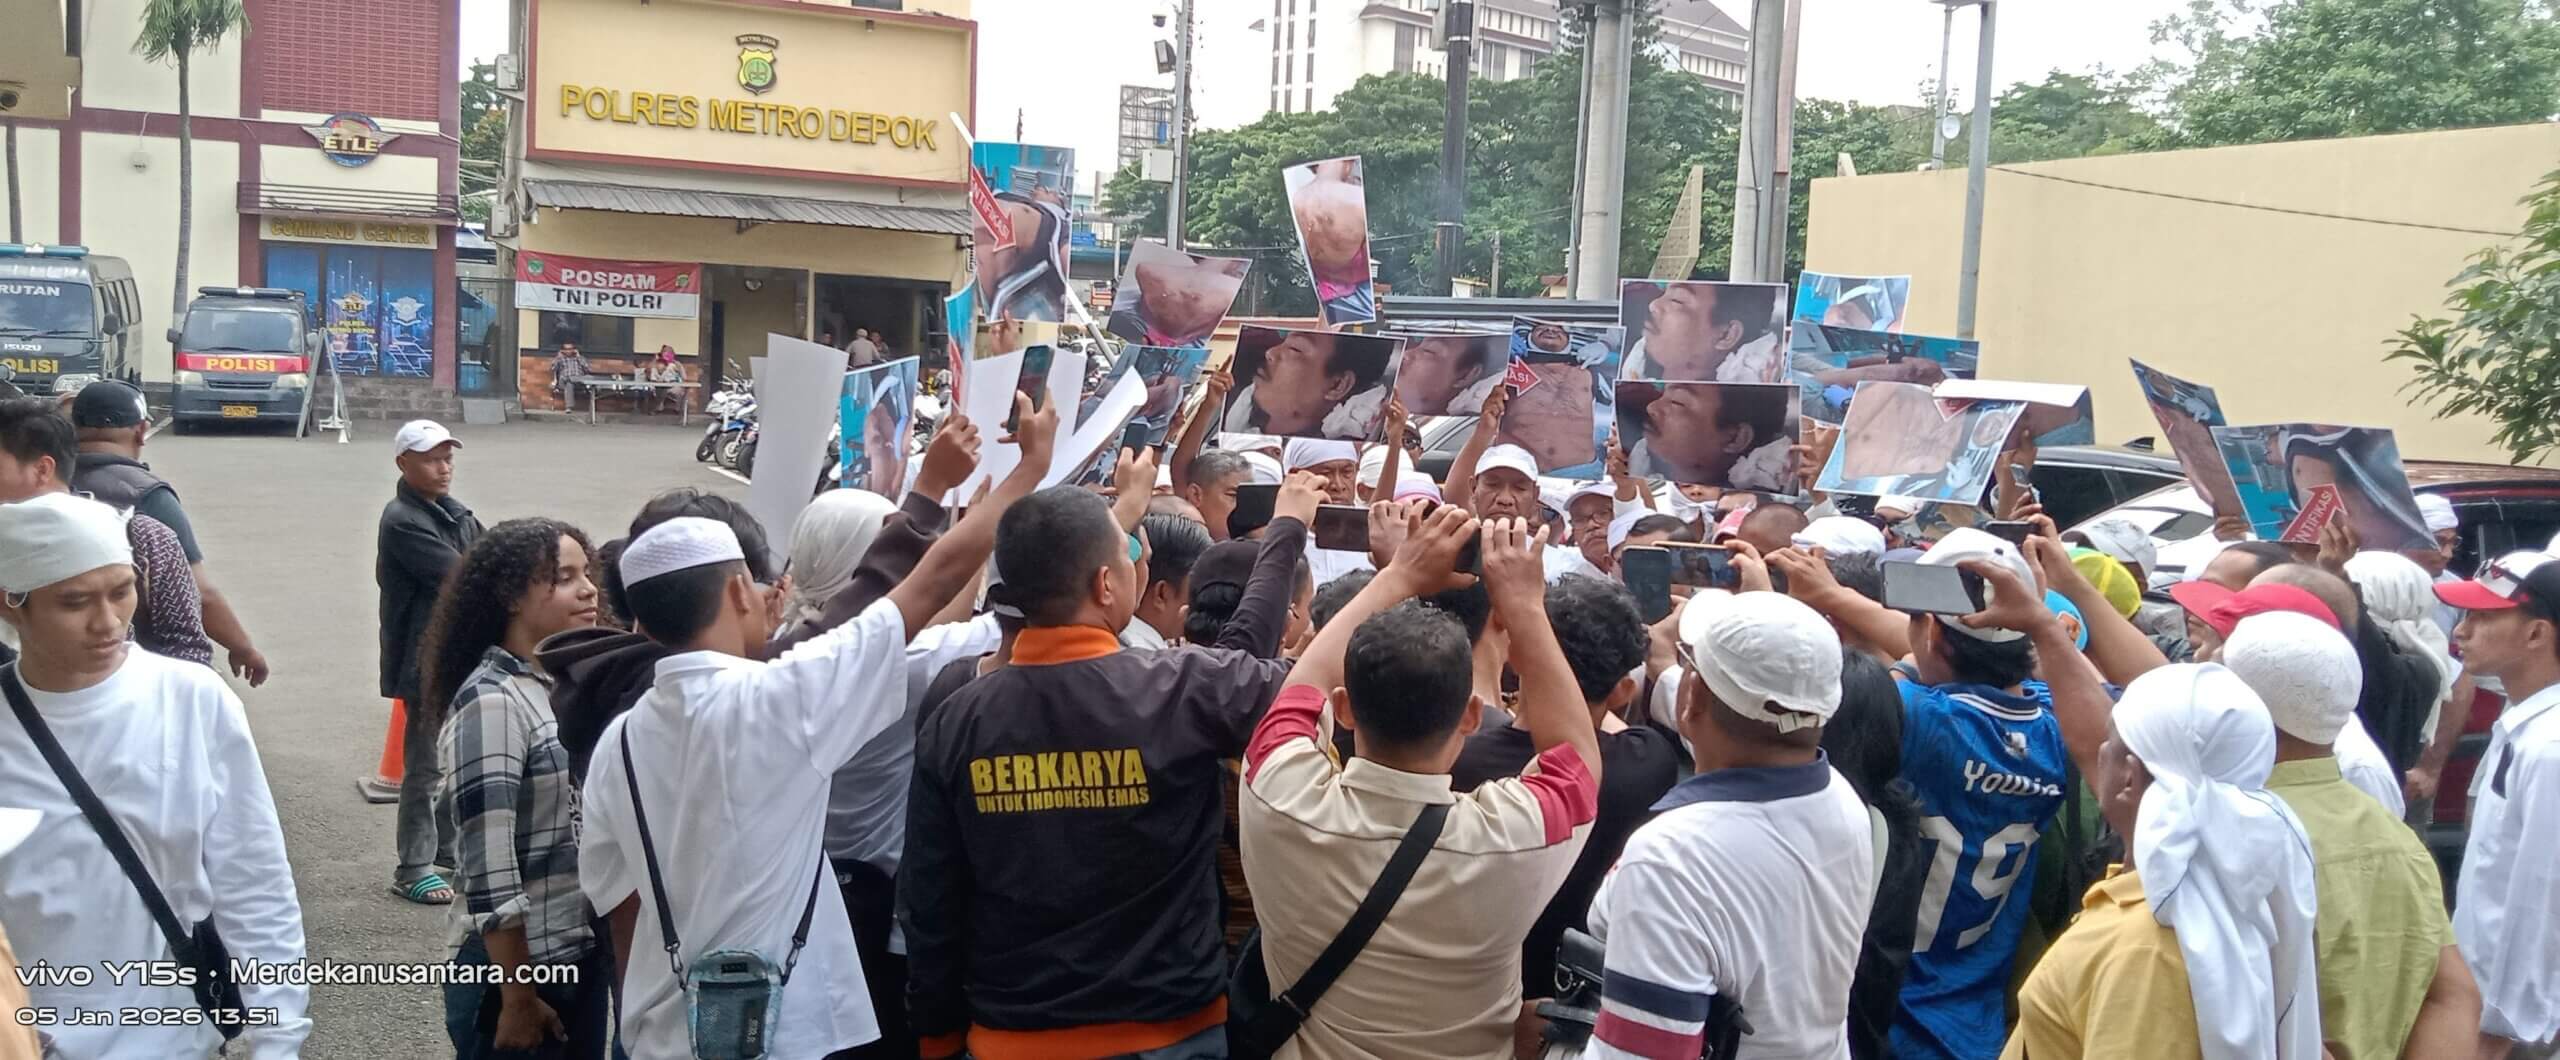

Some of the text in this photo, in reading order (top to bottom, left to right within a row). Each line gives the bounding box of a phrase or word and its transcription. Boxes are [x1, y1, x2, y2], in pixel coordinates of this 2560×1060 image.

[561, 84, 938, 151] POLRES METRO DEPOK
[323, 136, 379, 152] ETLE
[271, 220, 430, 244] COMMAND CENTER
[561, 268, 656, 290] POSPAM
[0, 284, 60, 297] RUTAN
[553, 288, 662, 310] TNI POLRI
[4, 343, 42, 351] ISUZU
[206, 358, 275, 371] POLISI
[970, 749, 1147, 794] BERKARYA
[975, 786, 1149, 813] UNTUK INDONESIA EMAS
